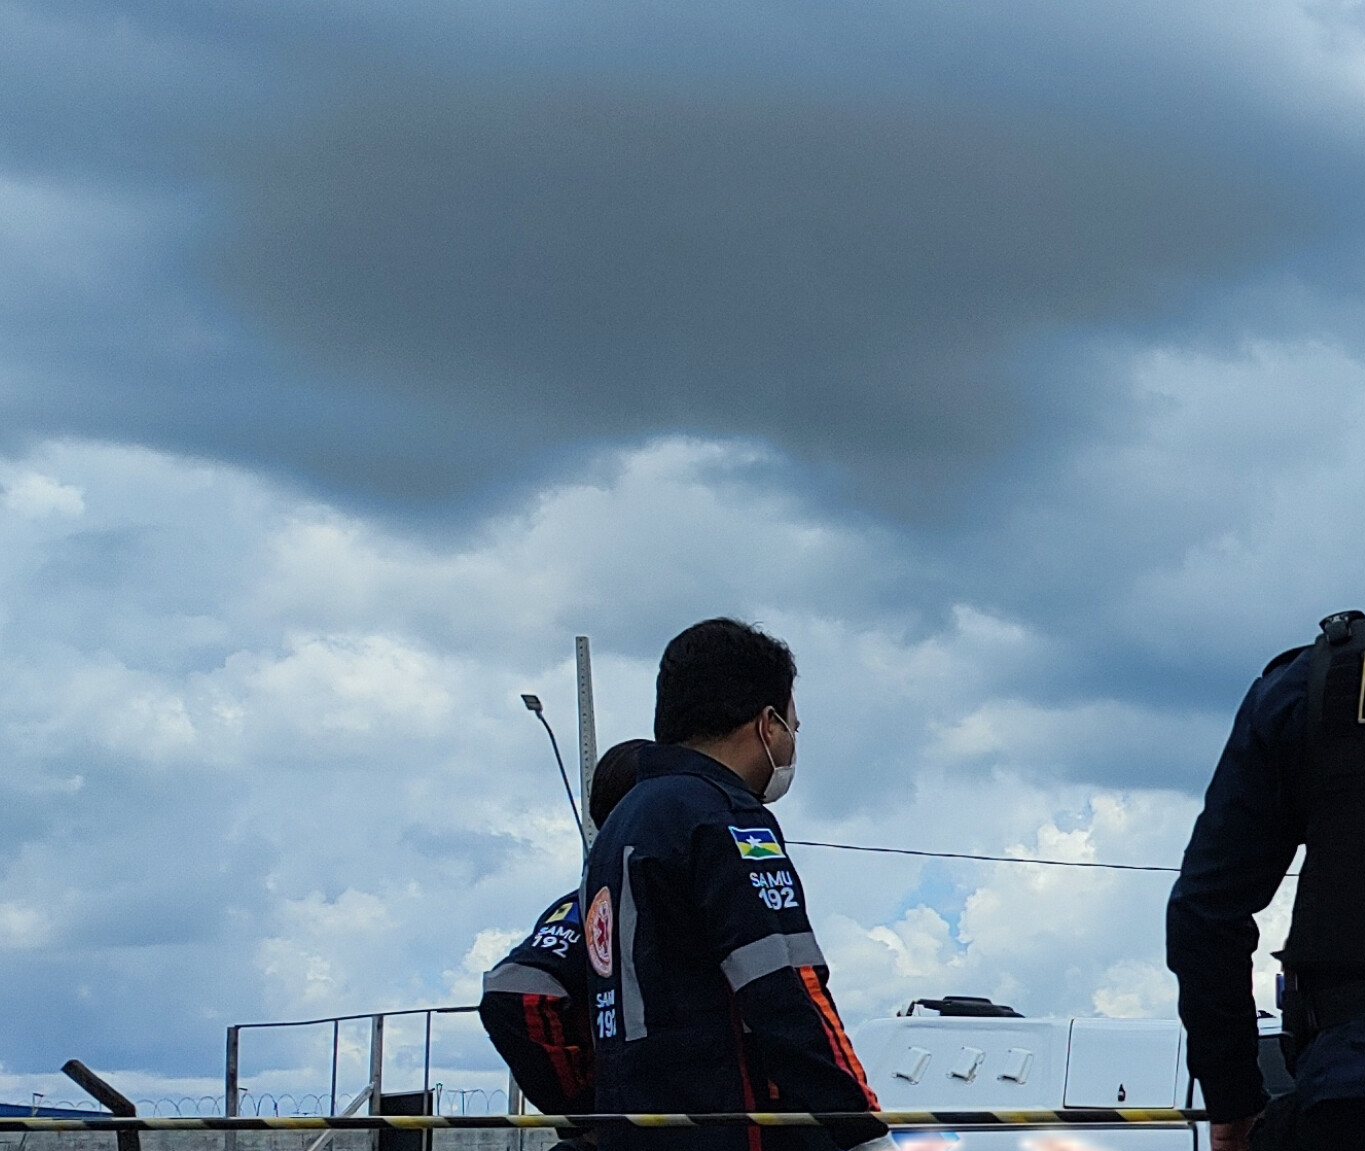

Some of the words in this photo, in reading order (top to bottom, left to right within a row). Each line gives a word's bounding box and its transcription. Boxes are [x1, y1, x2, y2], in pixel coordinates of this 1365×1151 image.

[749, 870, 793, 889] SAMU
[758, 886, 800, 910] 192
[537, 925, 581, 943] SAMU
[531, 935, 569, 959] 192
